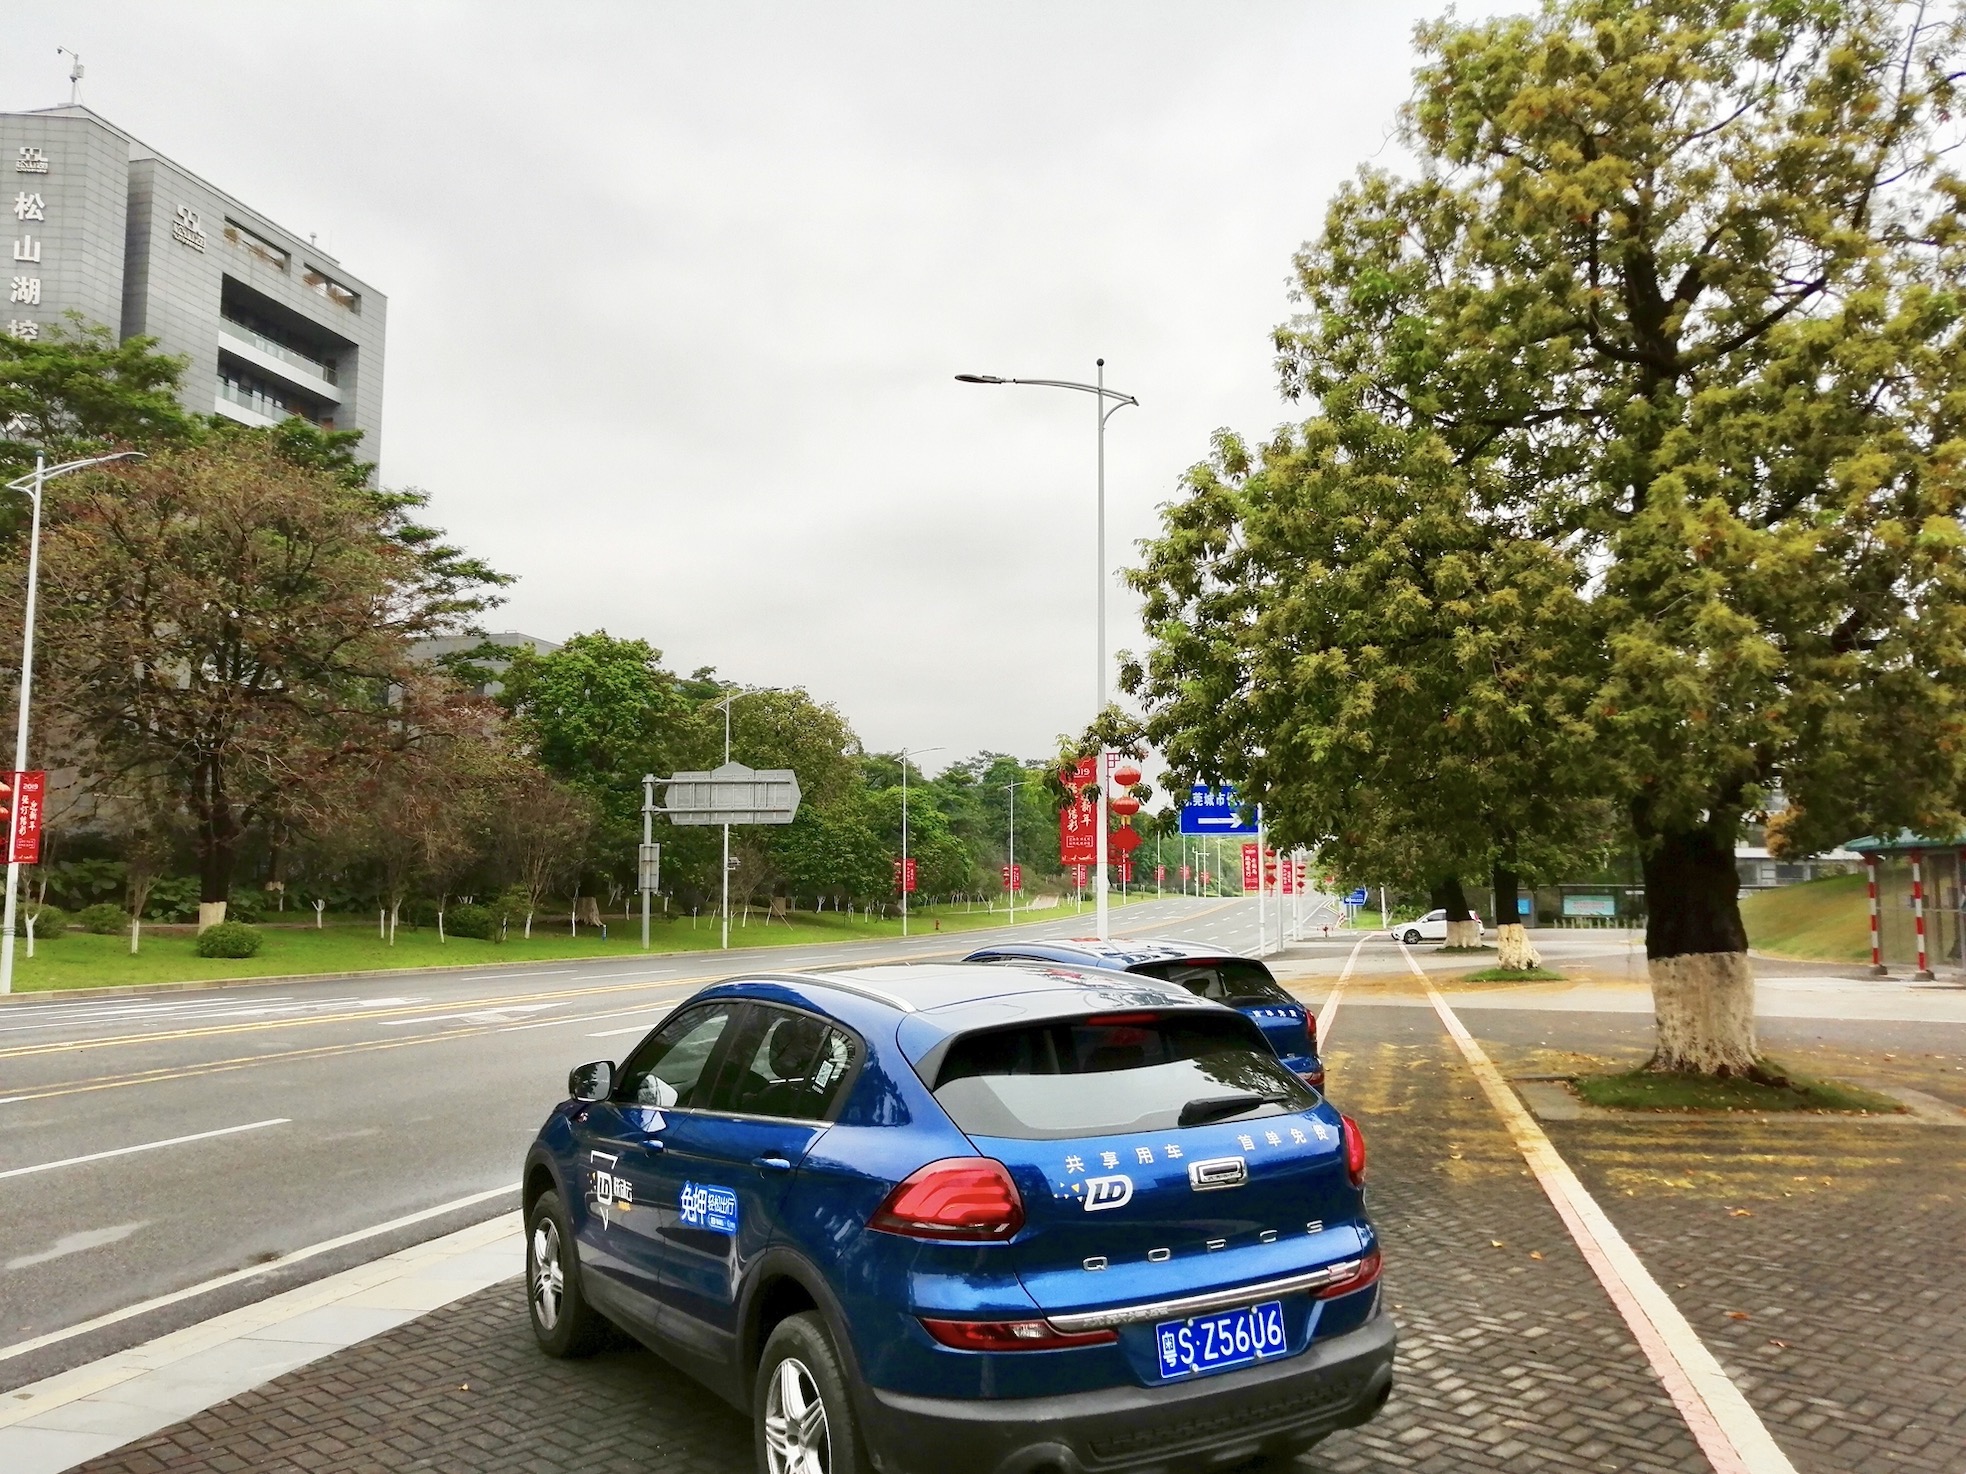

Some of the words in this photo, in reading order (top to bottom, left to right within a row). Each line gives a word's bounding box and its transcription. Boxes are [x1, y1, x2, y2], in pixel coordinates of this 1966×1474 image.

[22, 782, 39, 790] 2019
[1065, 1143, 1184, 1174] 共享用车
[1237, 1124, 1330, 1152] 首单免费
[680, 1182, 708, 1225] 免押
[1161, 1309, 1282, 1368] 粤S·Z56U6
